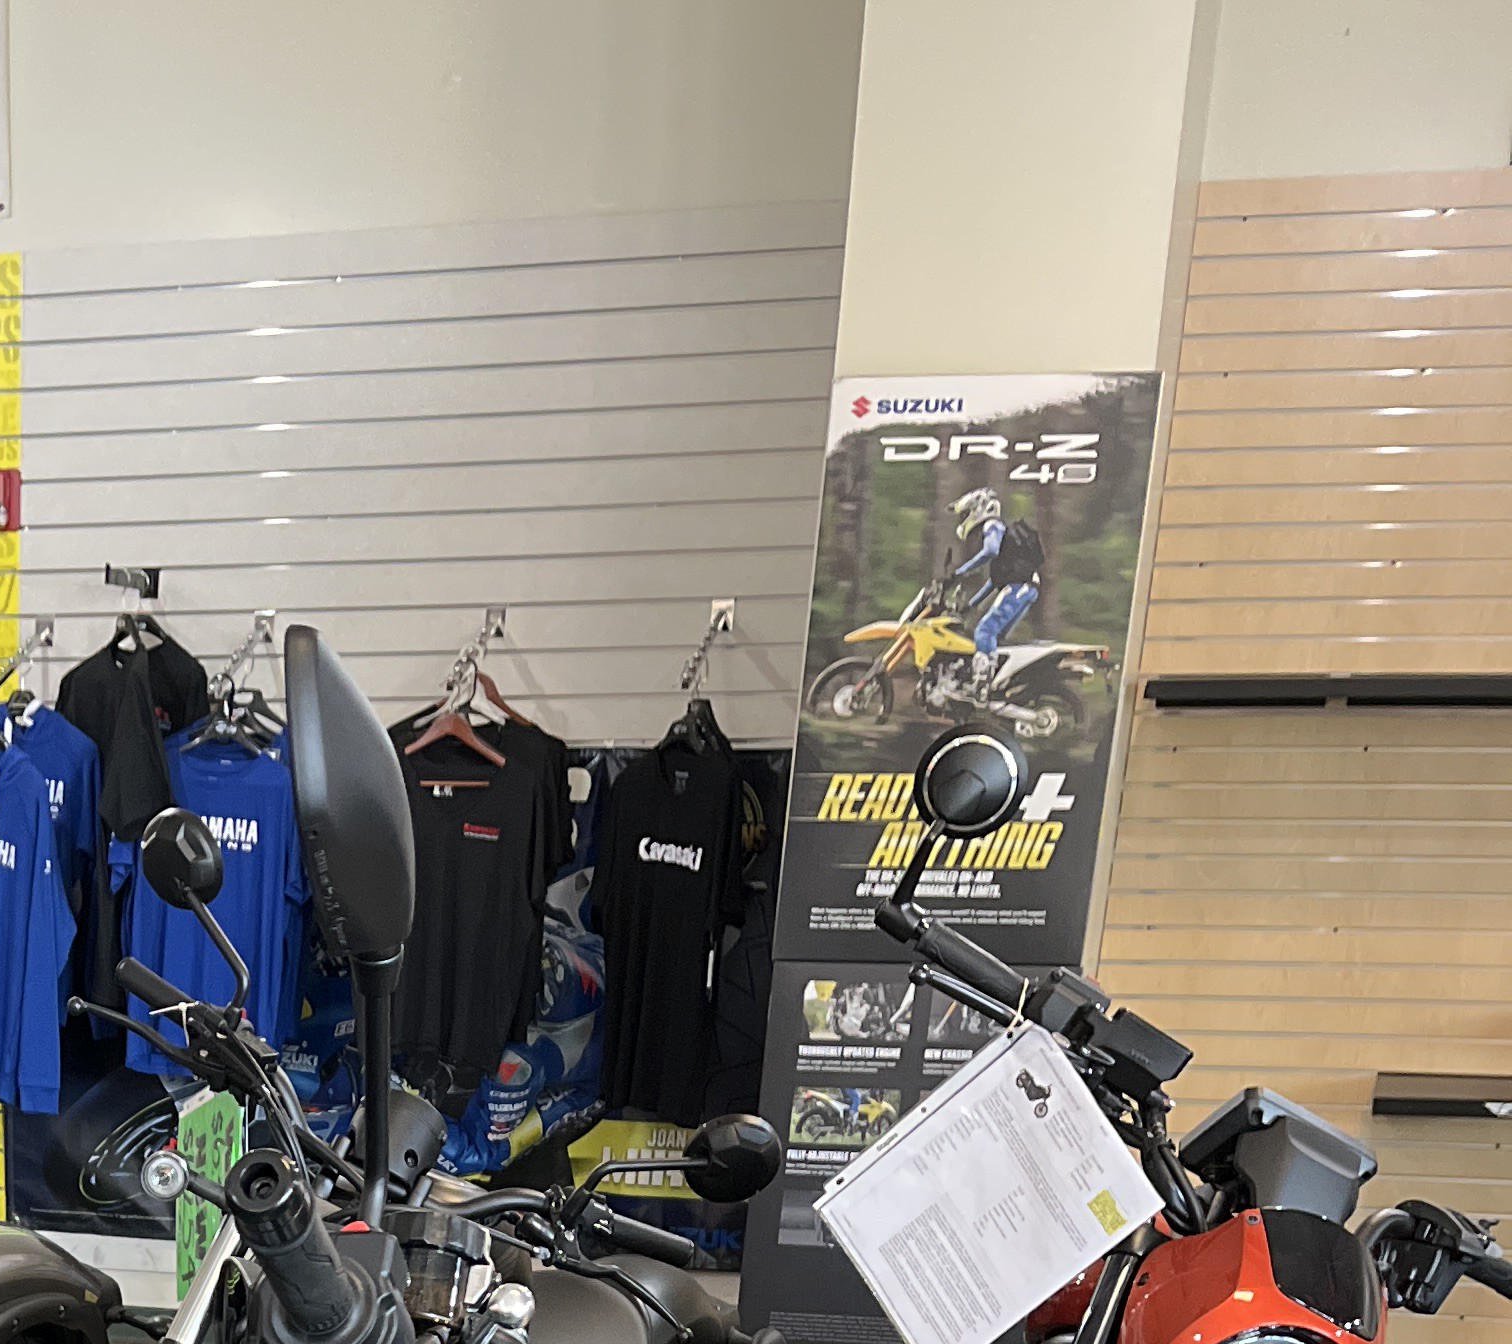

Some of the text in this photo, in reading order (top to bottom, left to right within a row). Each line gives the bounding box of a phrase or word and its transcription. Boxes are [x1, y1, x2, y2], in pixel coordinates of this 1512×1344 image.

[877, 398, 964, 414] SUZUKI
[879, 433, 1100, 462] DR-Z
[201, 815, 258, 845] MAHA
[647, 1128, 687, 1148] JOAN
